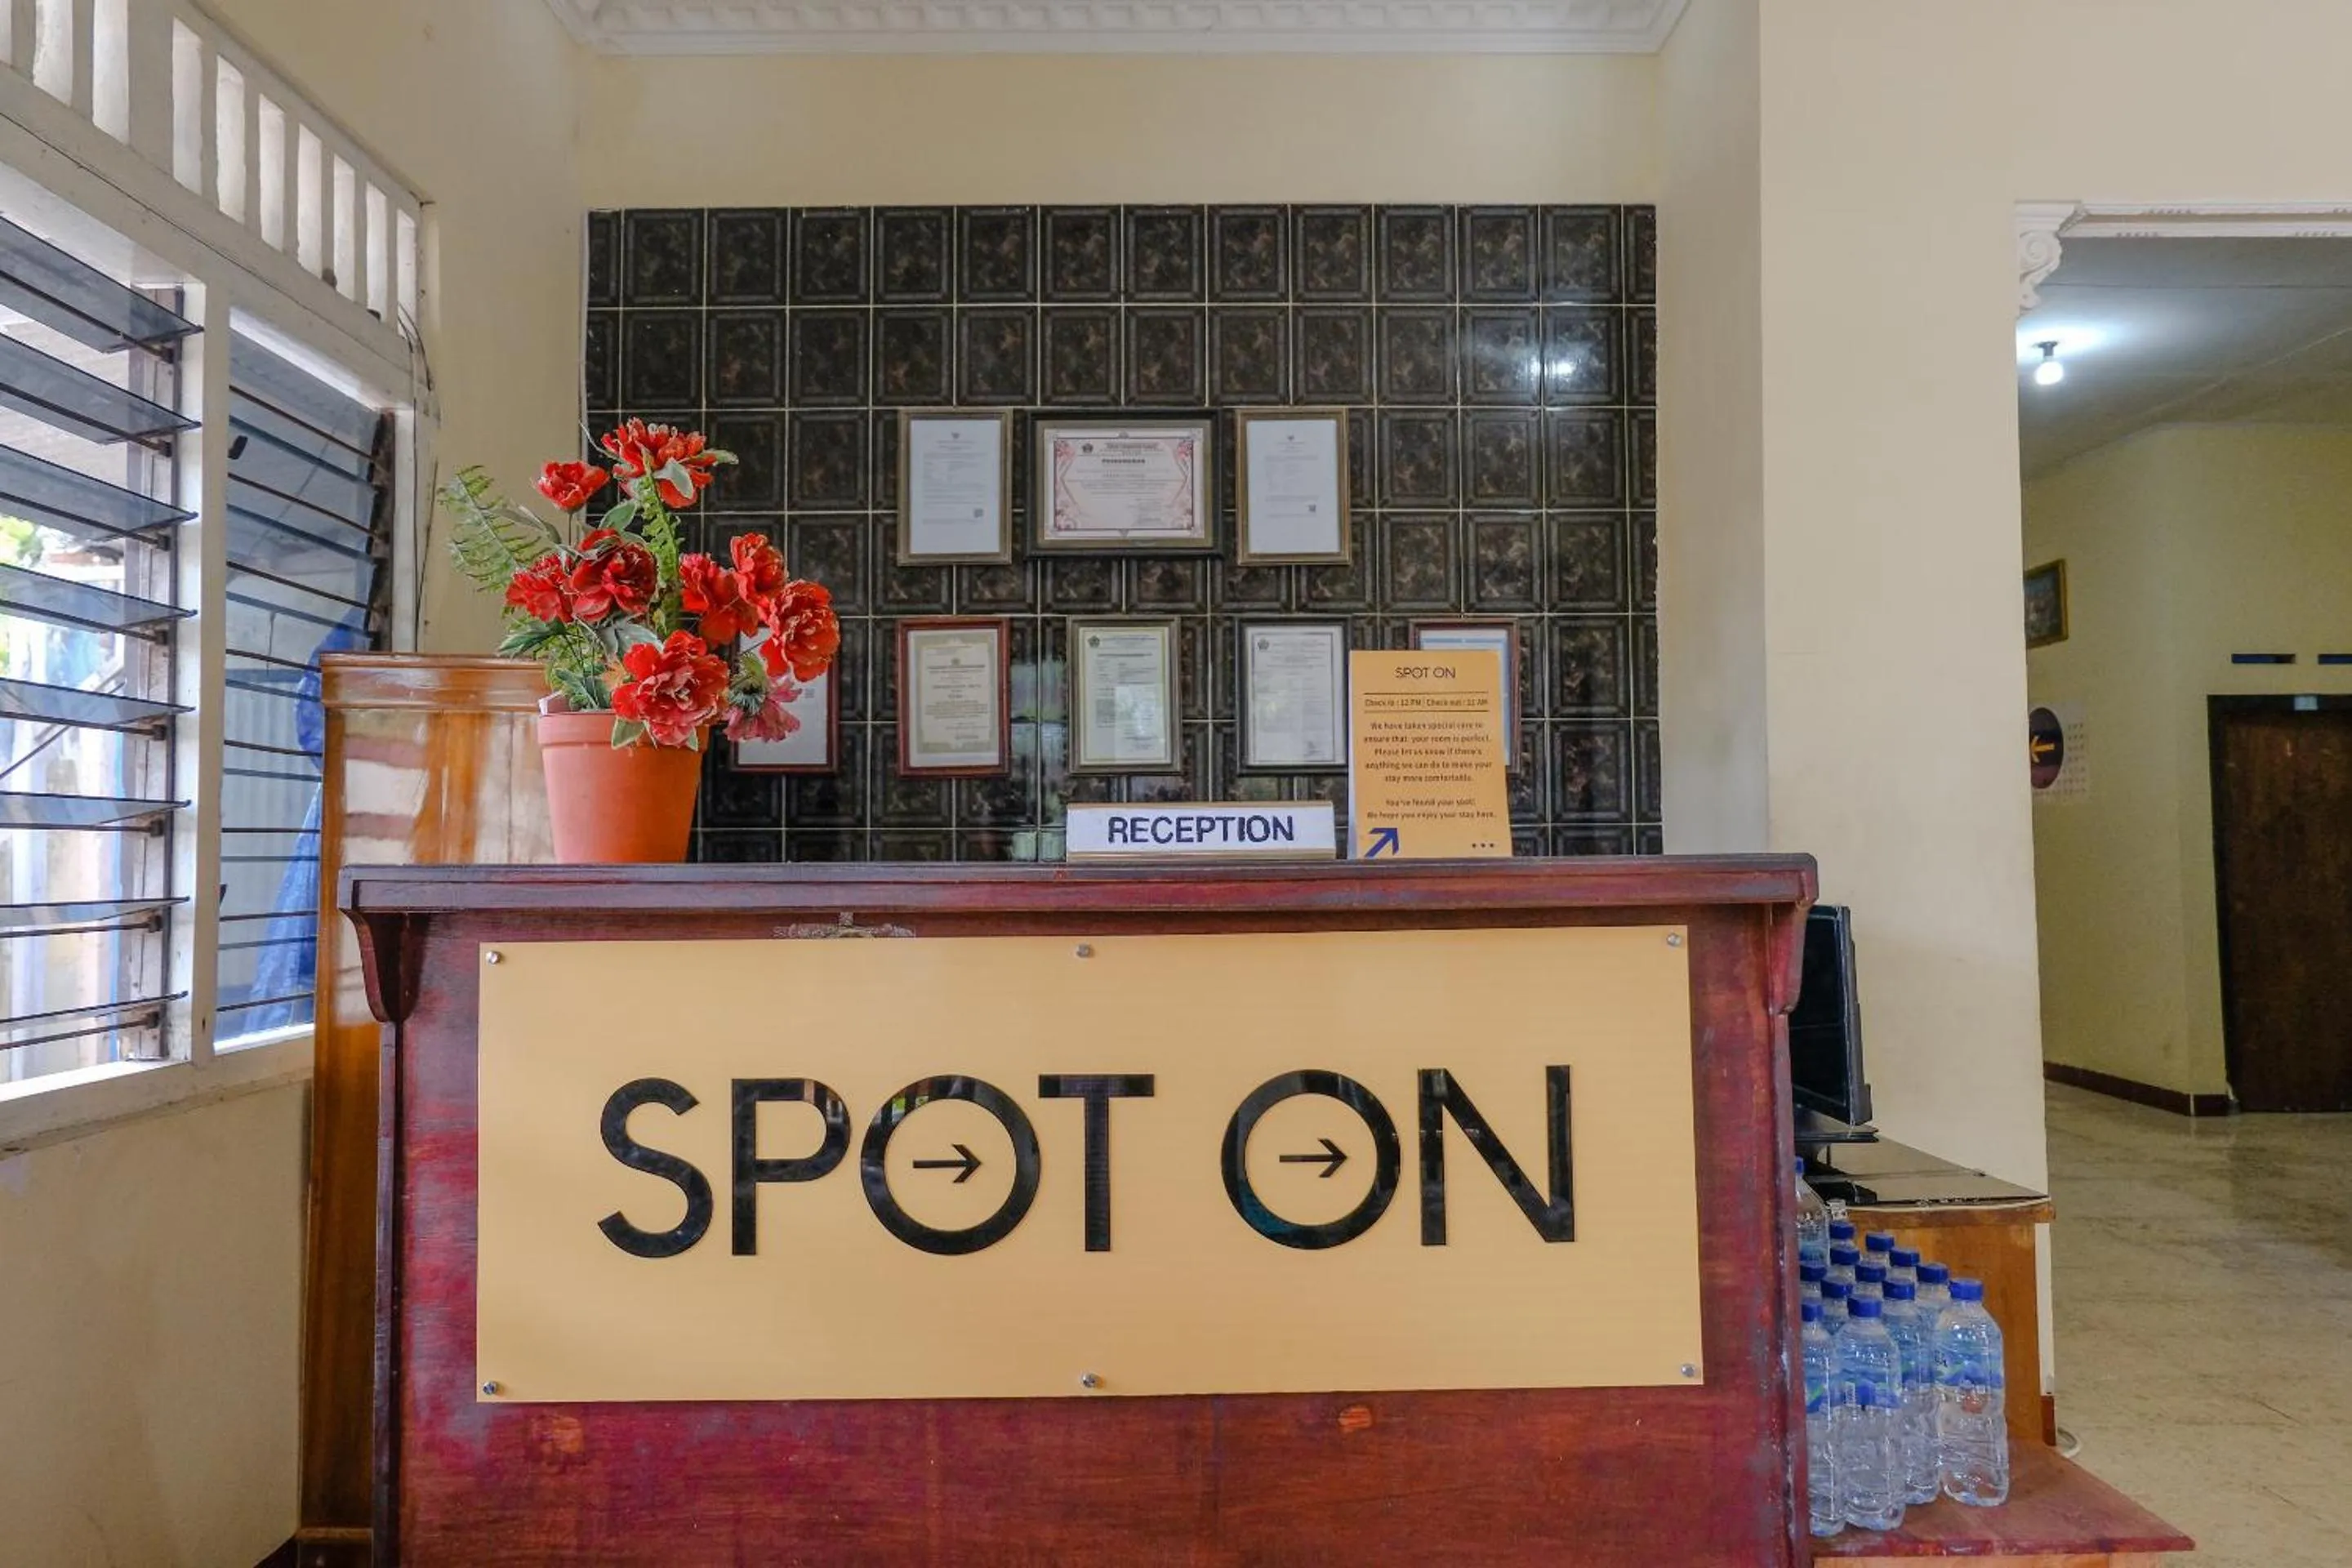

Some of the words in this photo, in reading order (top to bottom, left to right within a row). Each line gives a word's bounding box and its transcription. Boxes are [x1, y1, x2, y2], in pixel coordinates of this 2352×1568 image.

[1395, 666, 1429, 679] SPOT
[1433, 666, 1456, 679] ON
[1108, 815, 1294, 844] RECEPTION
[597, 1072, 1156, 1258] SPOT
[1220, 1064, 1576, 1251] ON
